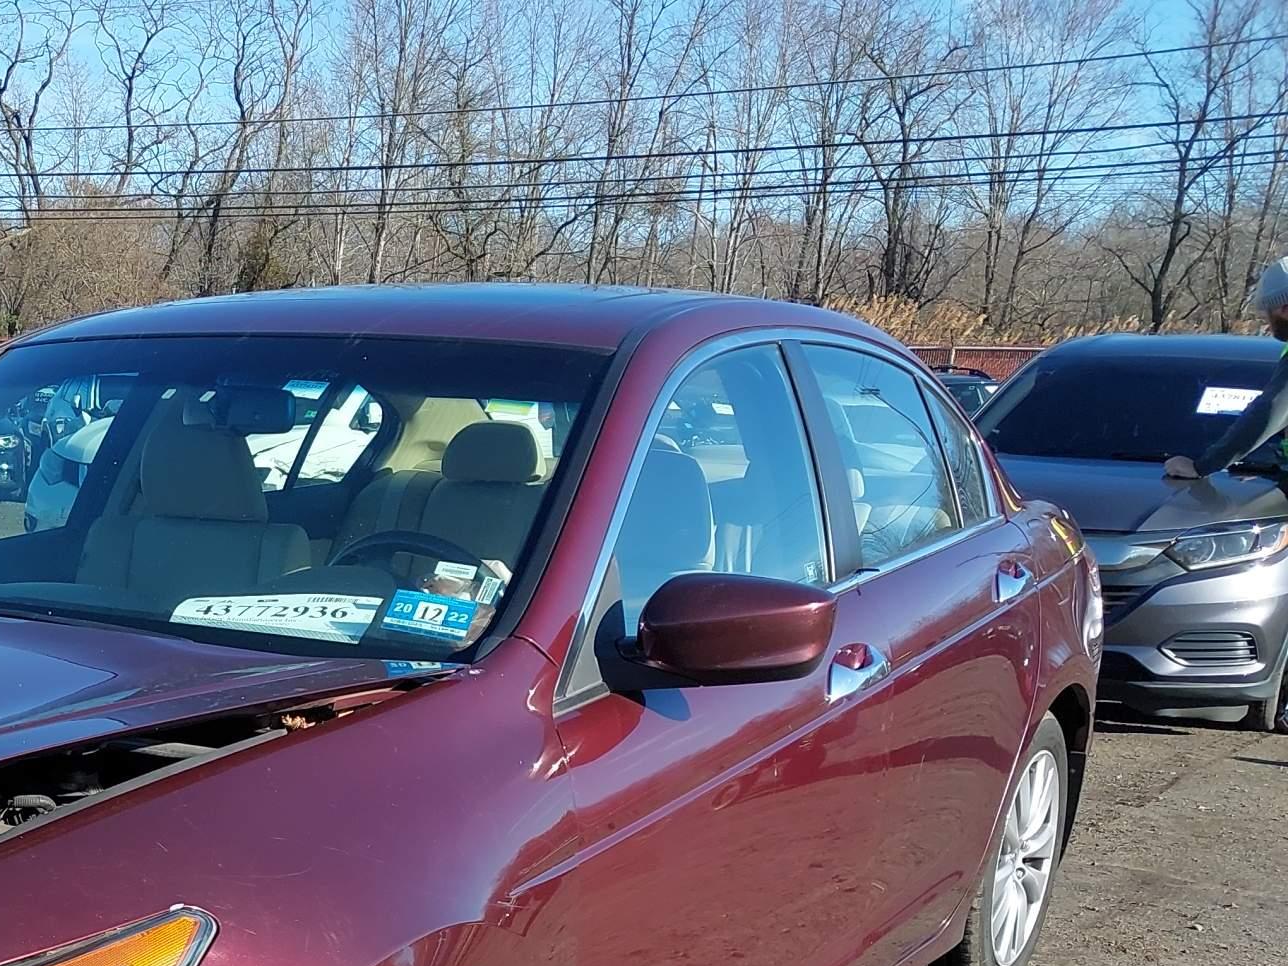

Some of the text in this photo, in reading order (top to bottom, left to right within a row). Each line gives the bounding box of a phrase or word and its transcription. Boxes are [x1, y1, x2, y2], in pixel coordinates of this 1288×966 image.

[195, 604, 350, 619] 43772936
[393, 602, 469, 624] 20 12 22
